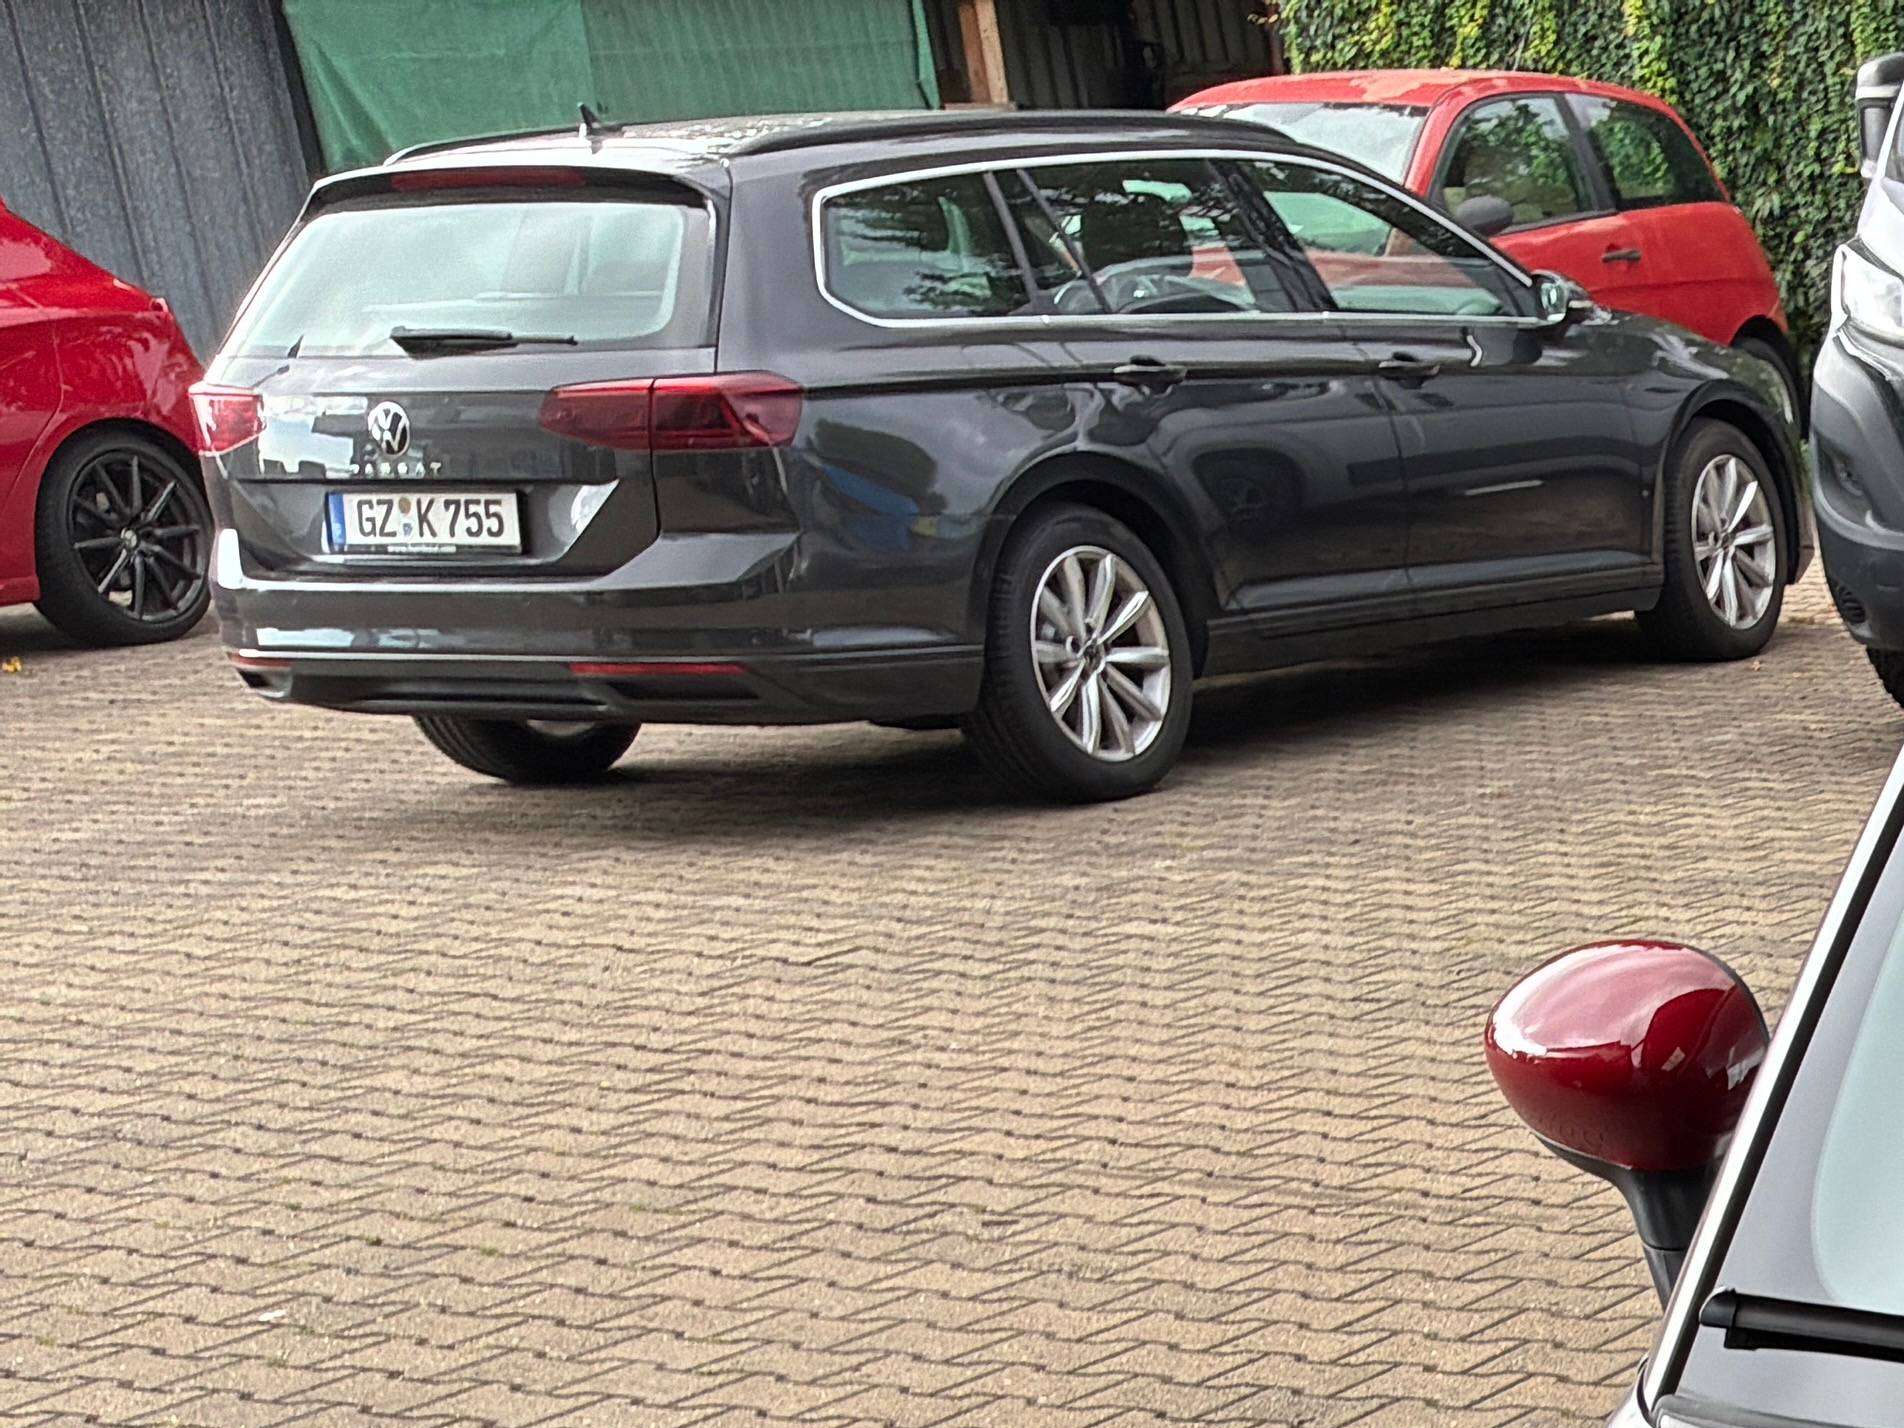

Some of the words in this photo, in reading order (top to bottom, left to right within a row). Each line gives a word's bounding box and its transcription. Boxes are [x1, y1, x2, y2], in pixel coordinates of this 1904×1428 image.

[356, 499, 397, 538] GZ
[417, 497, 437, 538] K
[444, 499, 504, 538] 755
